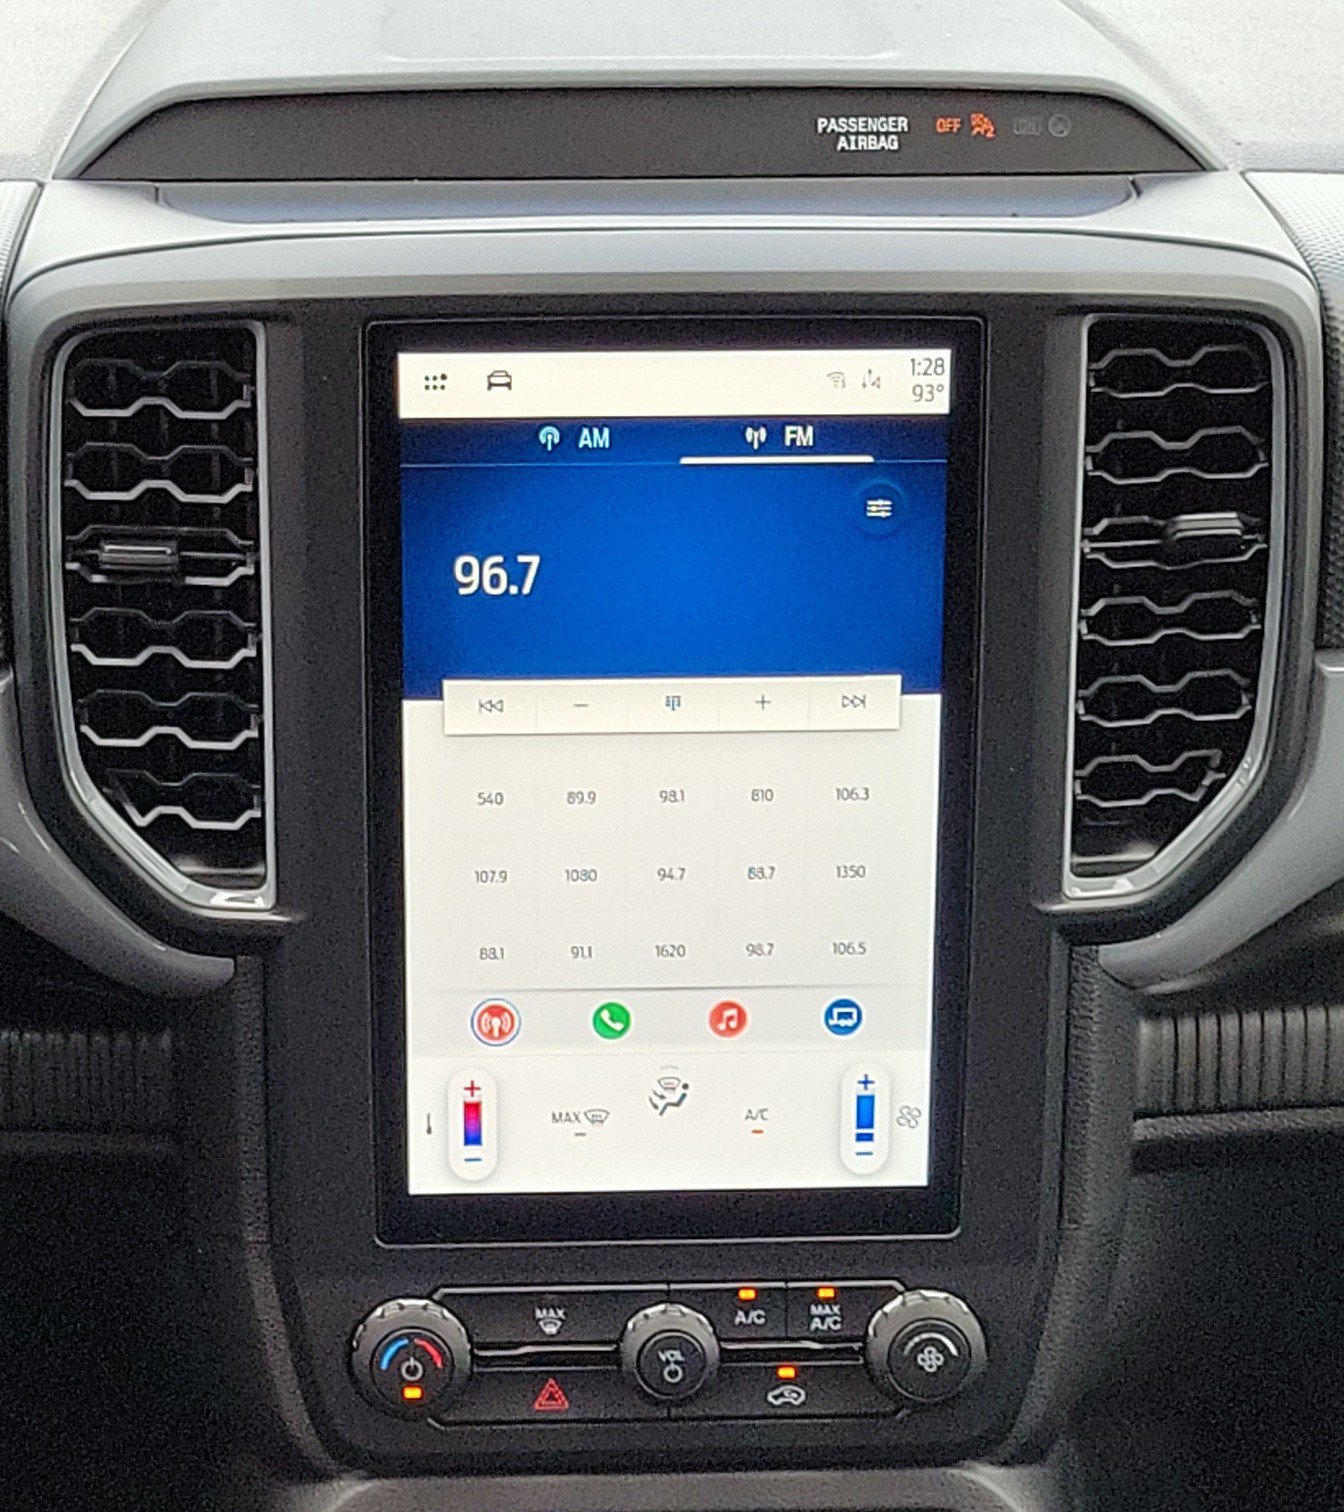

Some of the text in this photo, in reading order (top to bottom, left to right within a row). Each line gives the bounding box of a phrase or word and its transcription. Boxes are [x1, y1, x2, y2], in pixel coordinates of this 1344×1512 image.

[816, 116, 909, 133] PASSENGER
[935, 117, 961, 133] OFF
[837, 134, 899, 151] AIRBAG
[910, 357, 944, 376] 1:28
[912, 384, 944, 402] 93°
[578, 427, 610, 448] AM
[784, 425, 814, 446] FM
[454, 555, 541, 596] 96.7
[477, 792, 504, 806] 540
[566, 791, 597, 805] 89.9
[659, 790, 686, 803] 98.1
[751, 788, 774, 802] 810
[836, 787, 870, 801] 106.3
[474, 870, 507, 884] 107.9
[565, 869, 598, 882] 1080
[657, 867, 686, 881] 94.7
[747, 866, 776, 880] 88.7
[836, 865, 866, 879] 1350
[479, 947, 505, 960] 88.1
[745, 943, 775, 957] 98.7
[832, 942, 867, 956] 106.5
[551, 1111, 581, 1124] MAX
[745, 1108, 769, 1121] A/C
[534, 1306, 566, 1320] MAX
[810, 1303, 841, 1316] MAX
[734, 1308, 767, 1326] A/C
[809, 1315, 842, 1332] A/C
[657, 1349, 685, 1362] VOL
